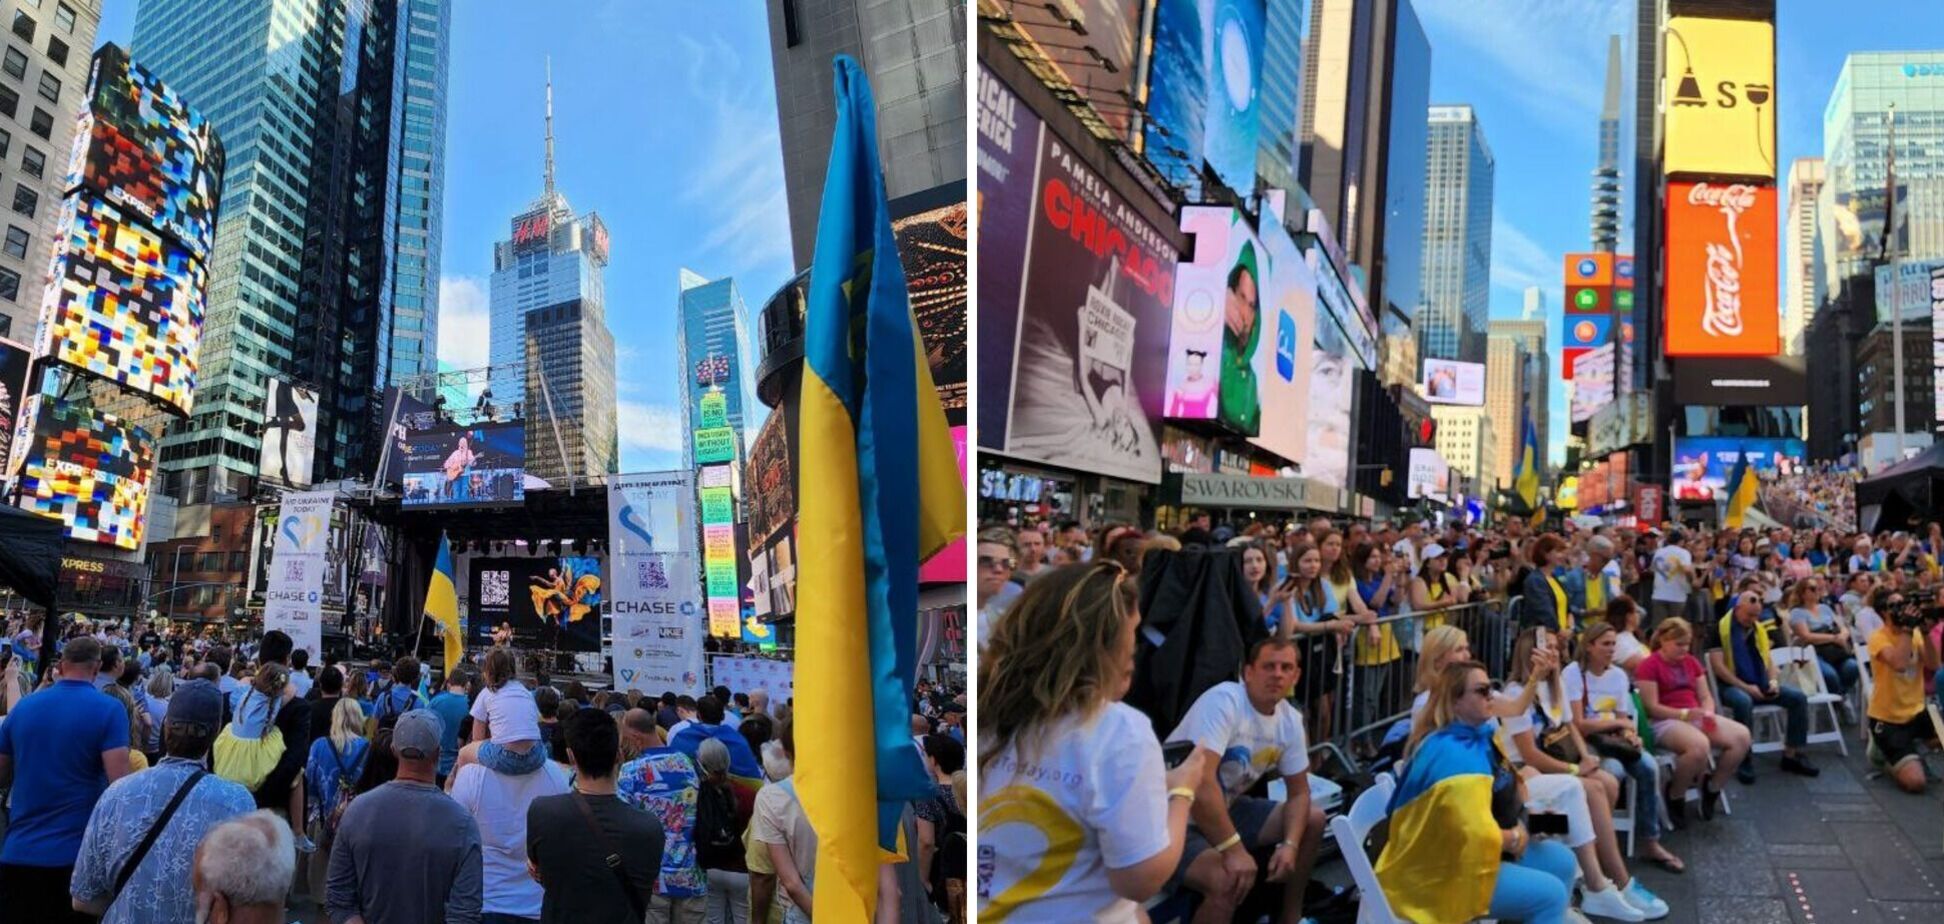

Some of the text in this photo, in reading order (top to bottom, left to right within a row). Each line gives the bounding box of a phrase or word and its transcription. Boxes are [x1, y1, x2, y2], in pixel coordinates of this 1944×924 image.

[977, 62, 1017, 129] ICAL
[1051, 141, 1111, 208] PAMELA
[1116, 204, 1179, 265] ANDERSON
[1044, 178, 1173, 308] CHICAGO
[1184, 477, 1306, 502] SWAROVSKI
[61, 558, 105, 573] XPRESS
[269, 590, 306, 602] CHASE
[615, 601, 676, 614] CHASE
